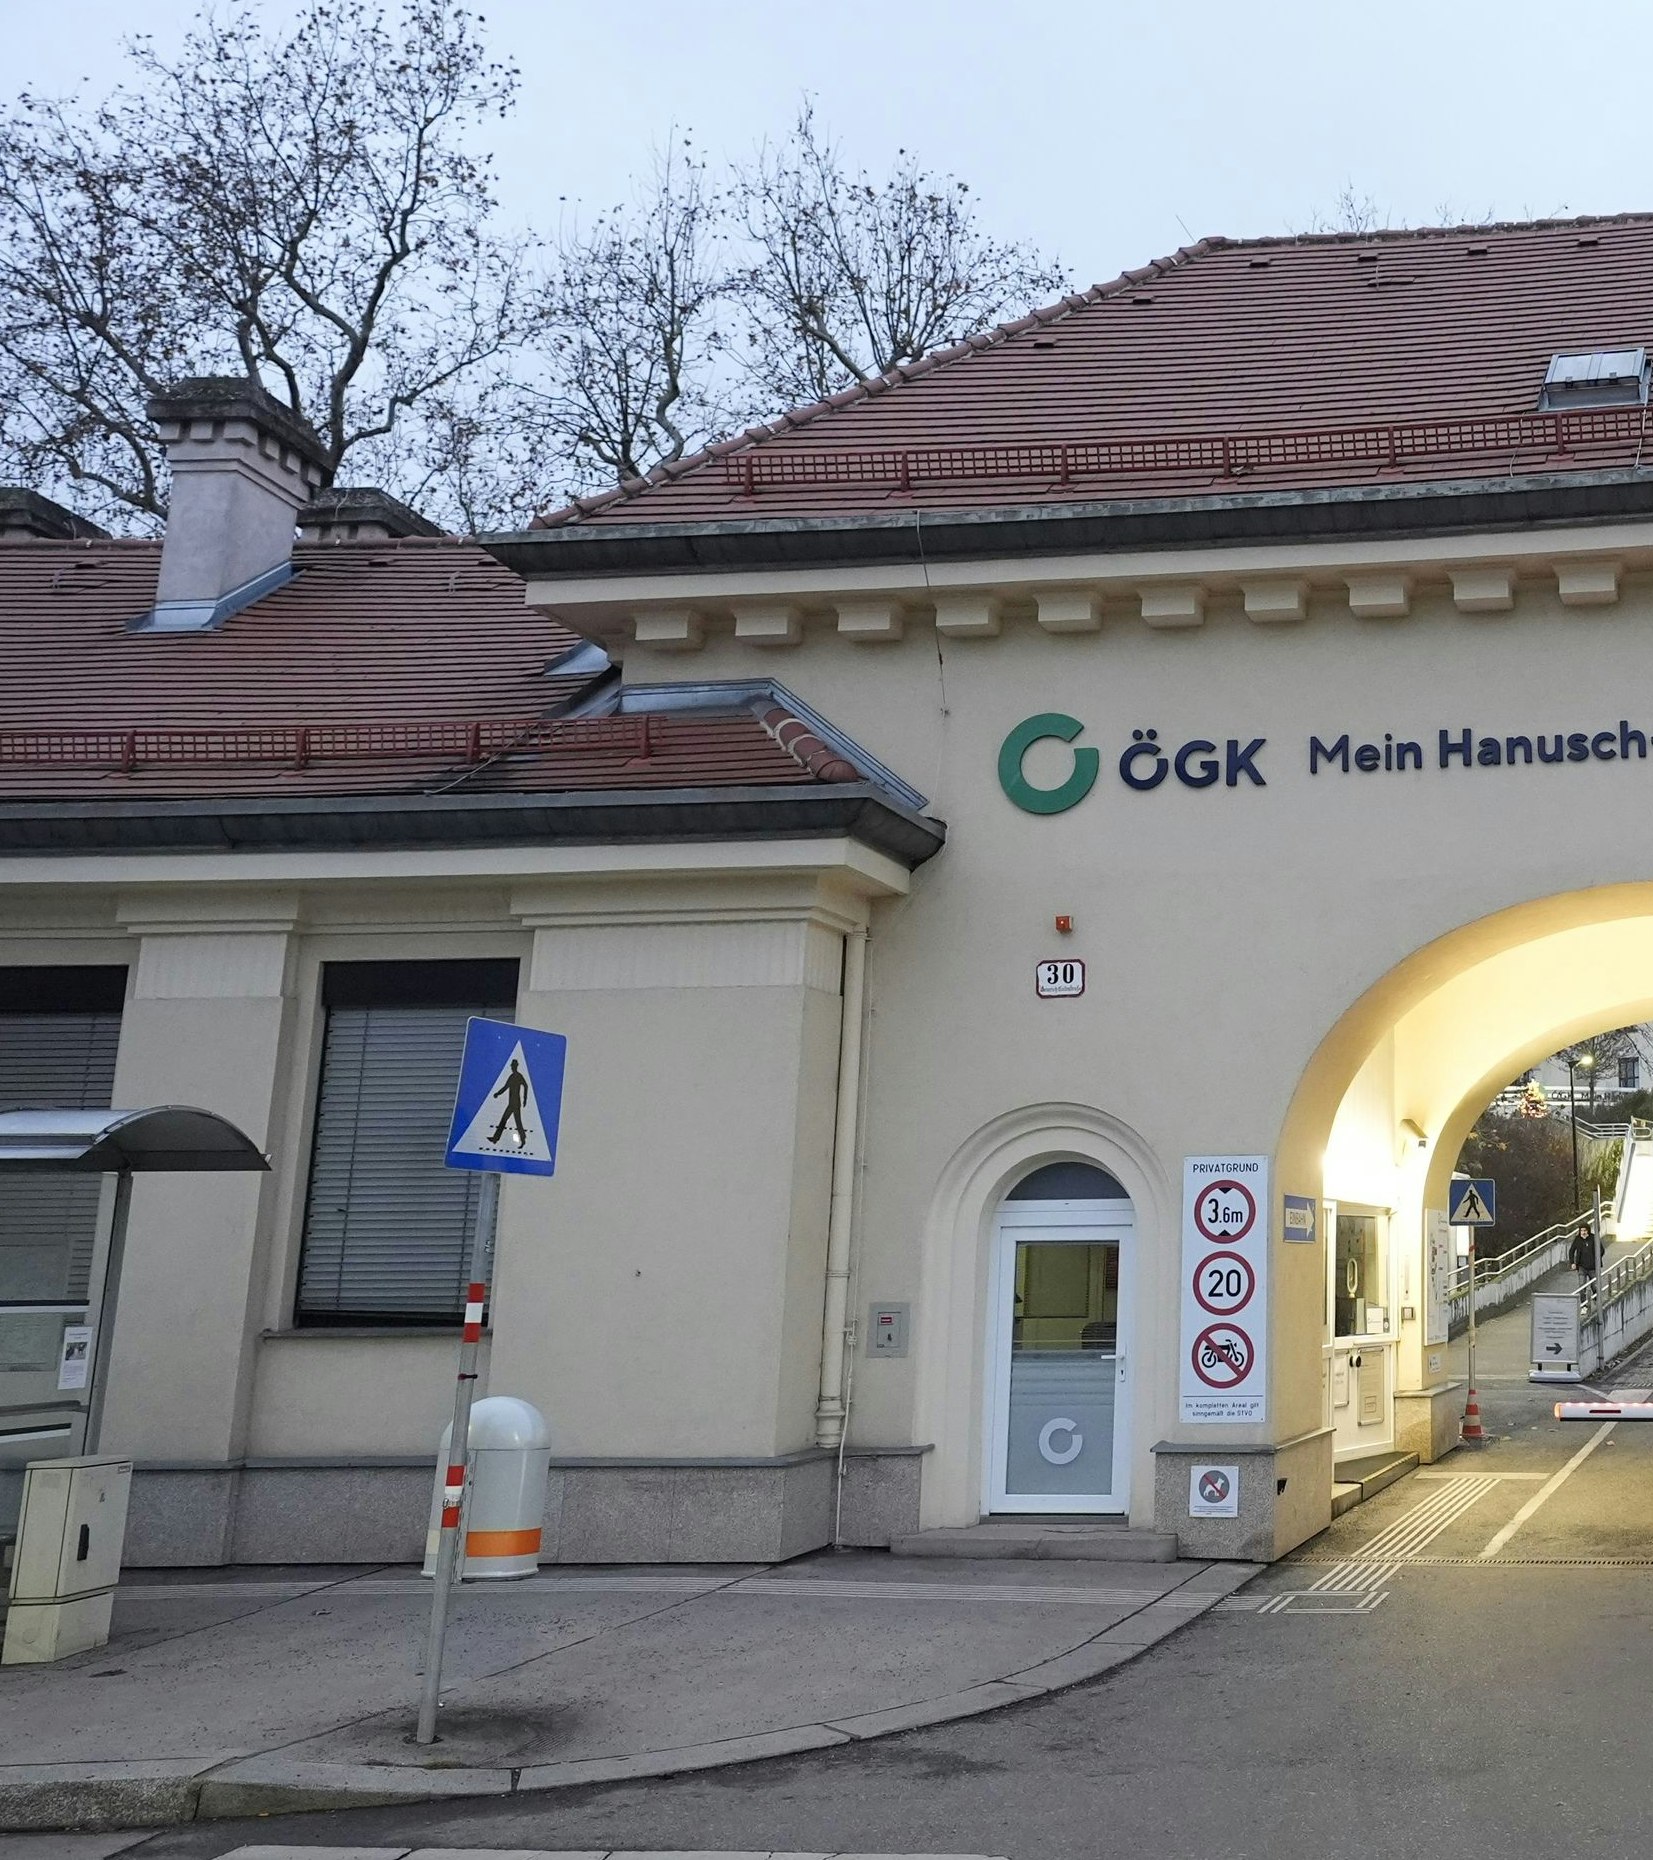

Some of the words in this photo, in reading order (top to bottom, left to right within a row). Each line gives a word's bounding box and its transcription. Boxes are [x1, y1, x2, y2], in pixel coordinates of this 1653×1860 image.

[1119, 728, 1267, 792] ÖGK
[1309, 733, 1423, 775] Mein
[1047, 963, 1074, 985] 30
[1192, 1162, 1259, 1173] PRIVATGRUND
[1207, 1198, 1243, 1224] 3.6m
[1207, 1269, 1242, 1298] 20
